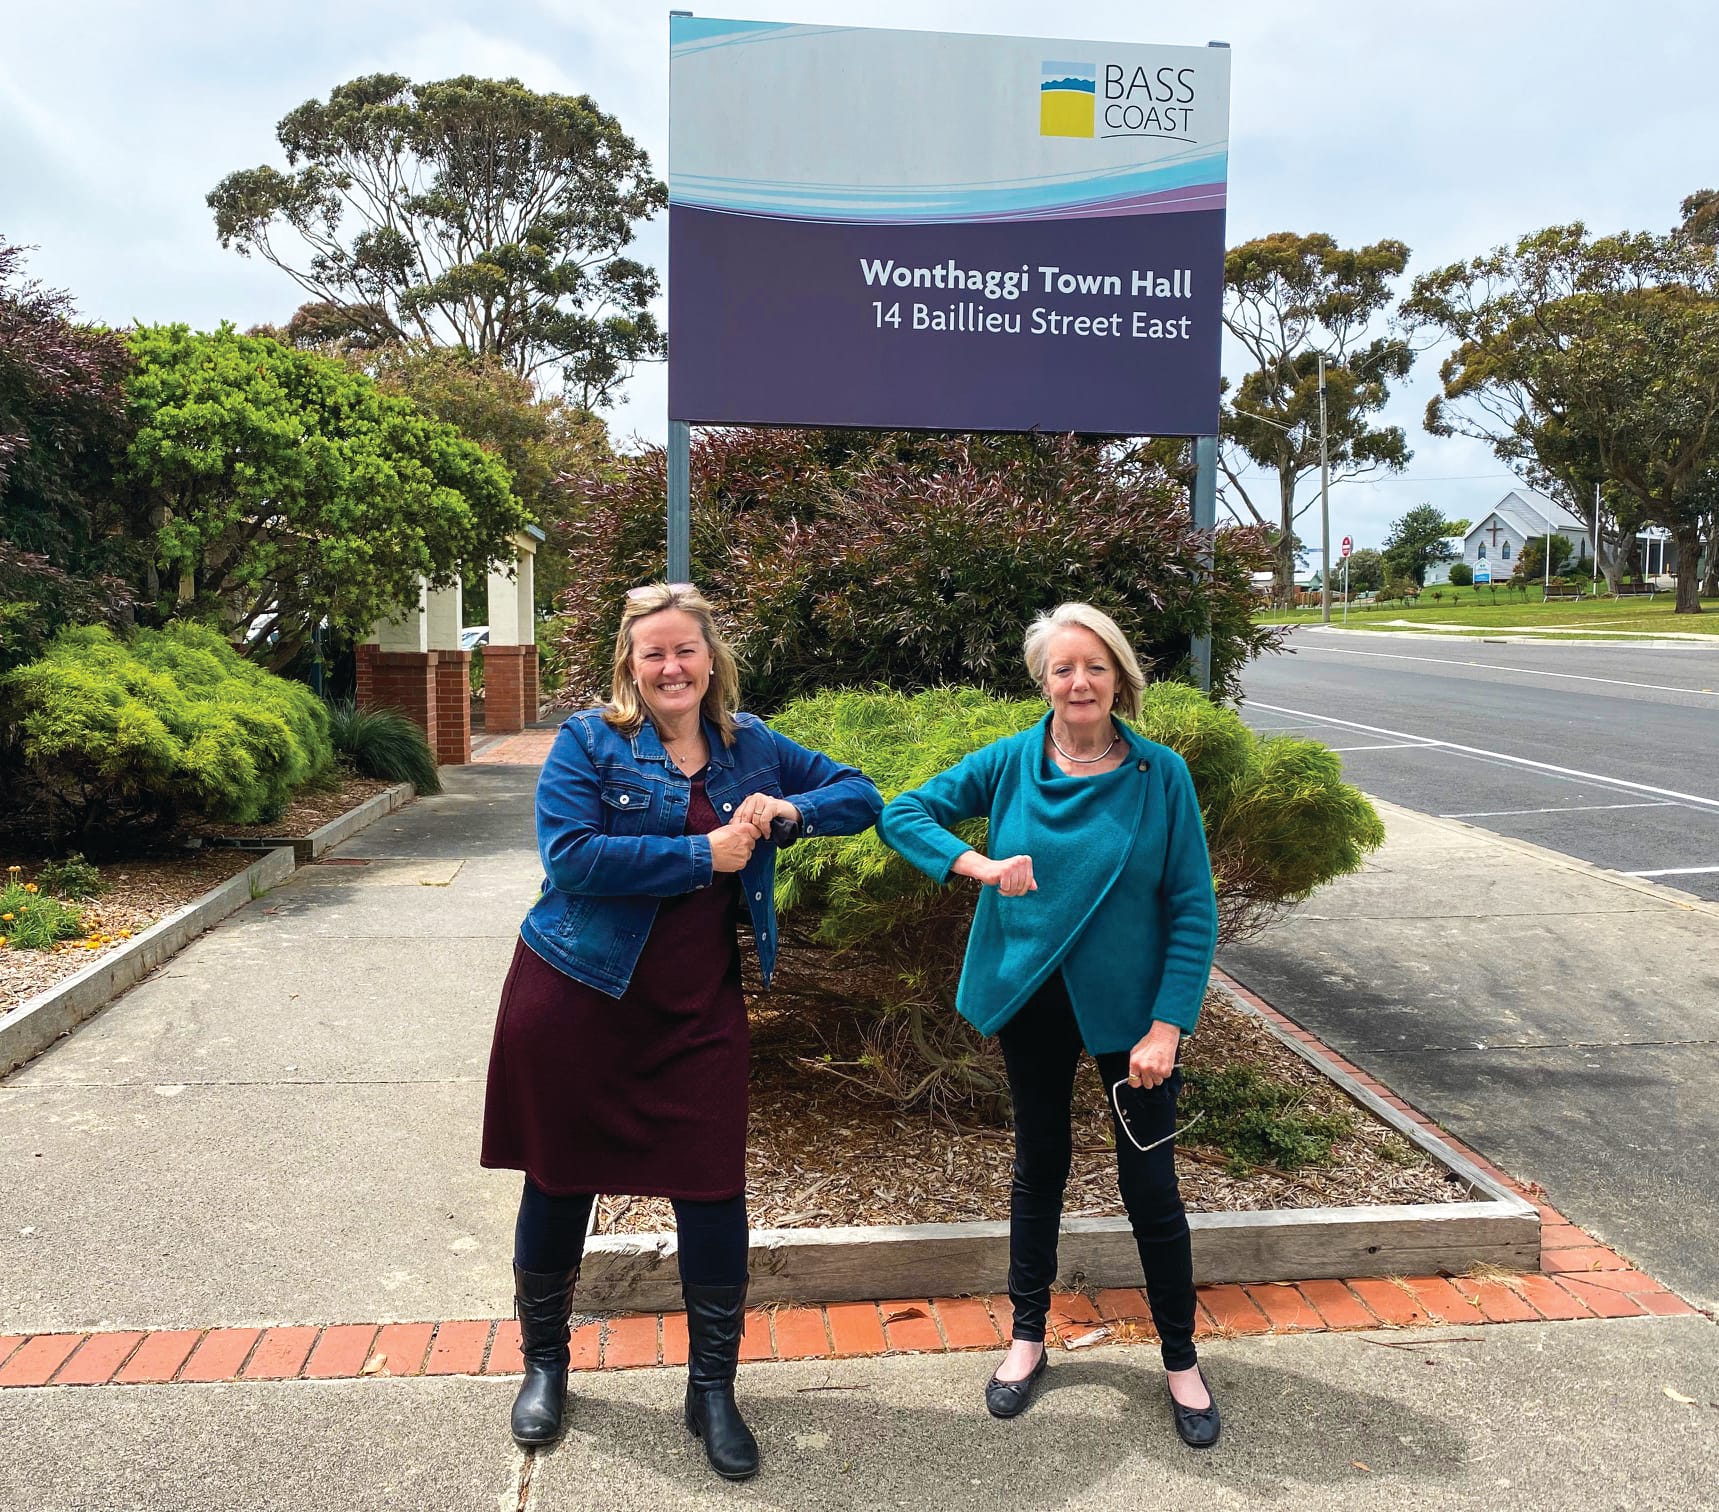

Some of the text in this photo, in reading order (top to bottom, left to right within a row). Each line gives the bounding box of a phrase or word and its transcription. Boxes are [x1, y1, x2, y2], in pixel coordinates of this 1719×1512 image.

[1105, 64, 1195, 104] BASS
[1104, 104, 1194, 132] COAST
[859, 258, 1192, 300] Wonthaggi Town Hall
[872, 301, 1192, 339] 14 Baillieu Street East
